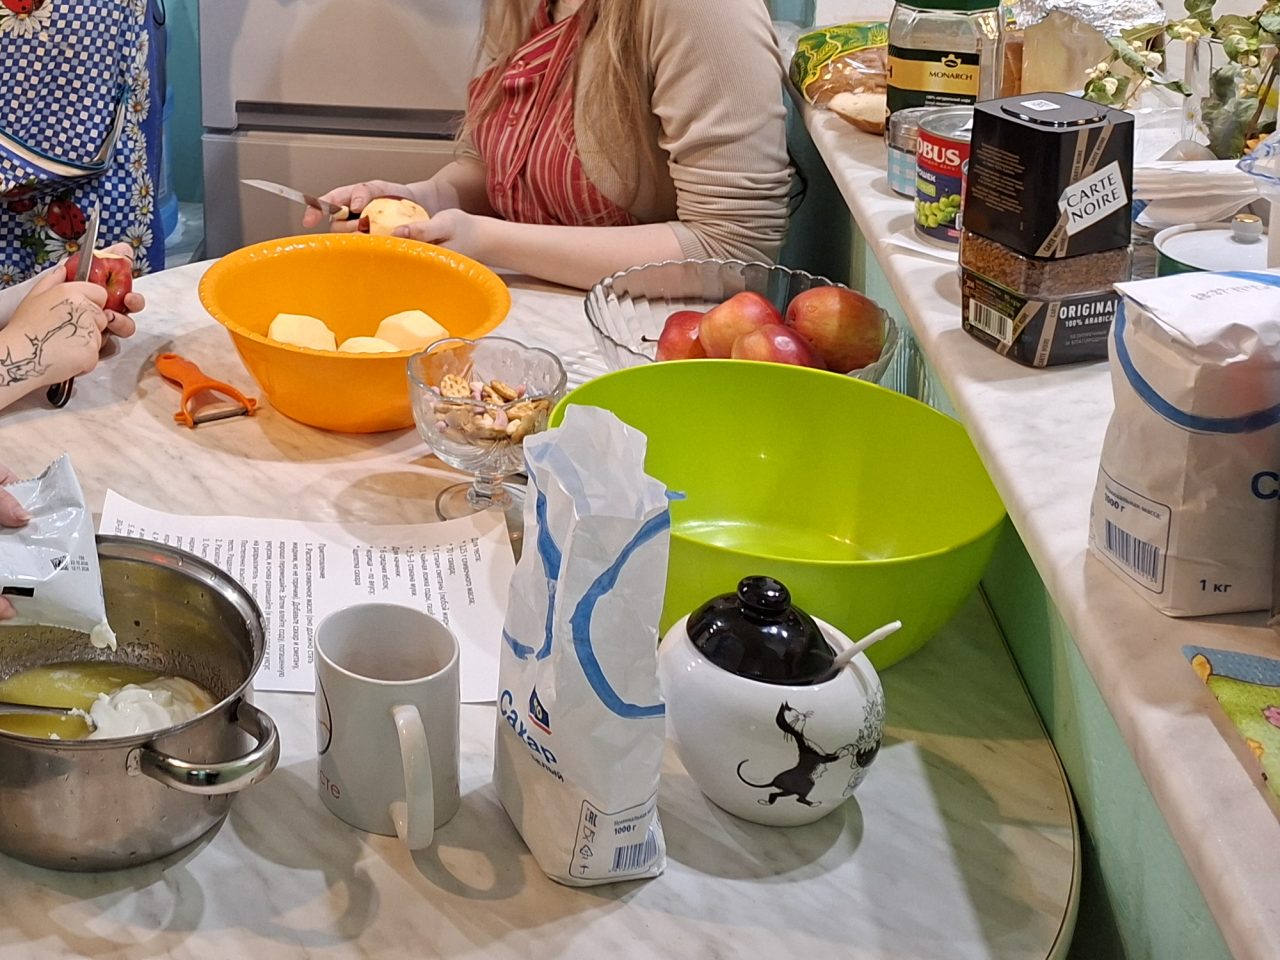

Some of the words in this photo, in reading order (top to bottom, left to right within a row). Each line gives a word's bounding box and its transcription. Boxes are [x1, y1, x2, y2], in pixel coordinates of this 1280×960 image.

[928, 71, 973, 81] MONARCH
[1066, 172, 1117, 208] CARTE
[1071, 187, 1121, 224] NOIRE
[1065, 319, 1083, 328] 100%
[1084, 314, 1114, 326] ARABICA
[1199, 579, 1207, 591] 1
[1213, 583, 1232, 593] кг
[277, 644, 285, 677] погашенную
[500, 689, 557, 765] Сахар
[614, 824, 631, 835] 1000
